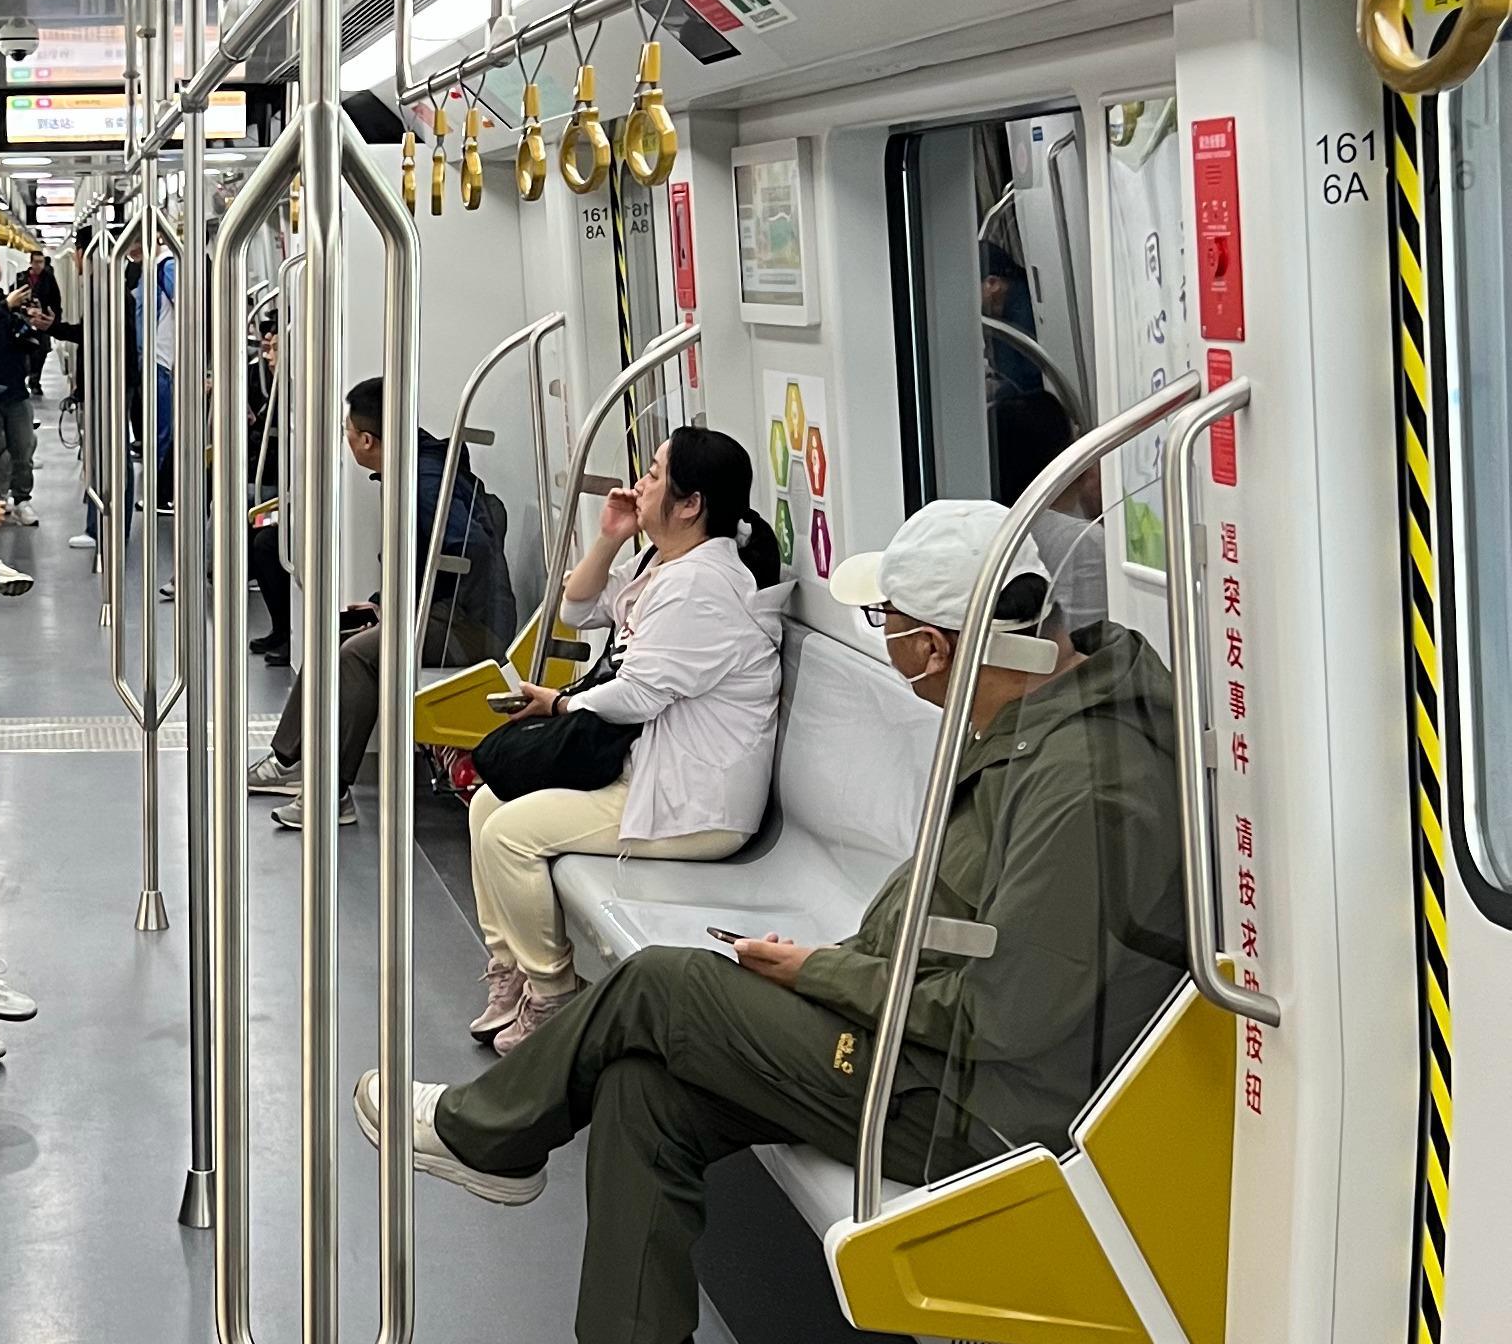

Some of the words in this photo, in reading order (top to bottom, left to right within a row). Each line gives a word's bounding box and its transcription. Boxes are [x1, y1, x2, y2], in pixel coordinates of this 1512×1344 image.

[1316, 130, 1376, 165] 161
[1322, 171, 1370, 205] 6A
[582, 208, 609, 223] 161
[585, 224, 606, 240] 8A
[1220, 520, 1250, 776] 遇突发事件
